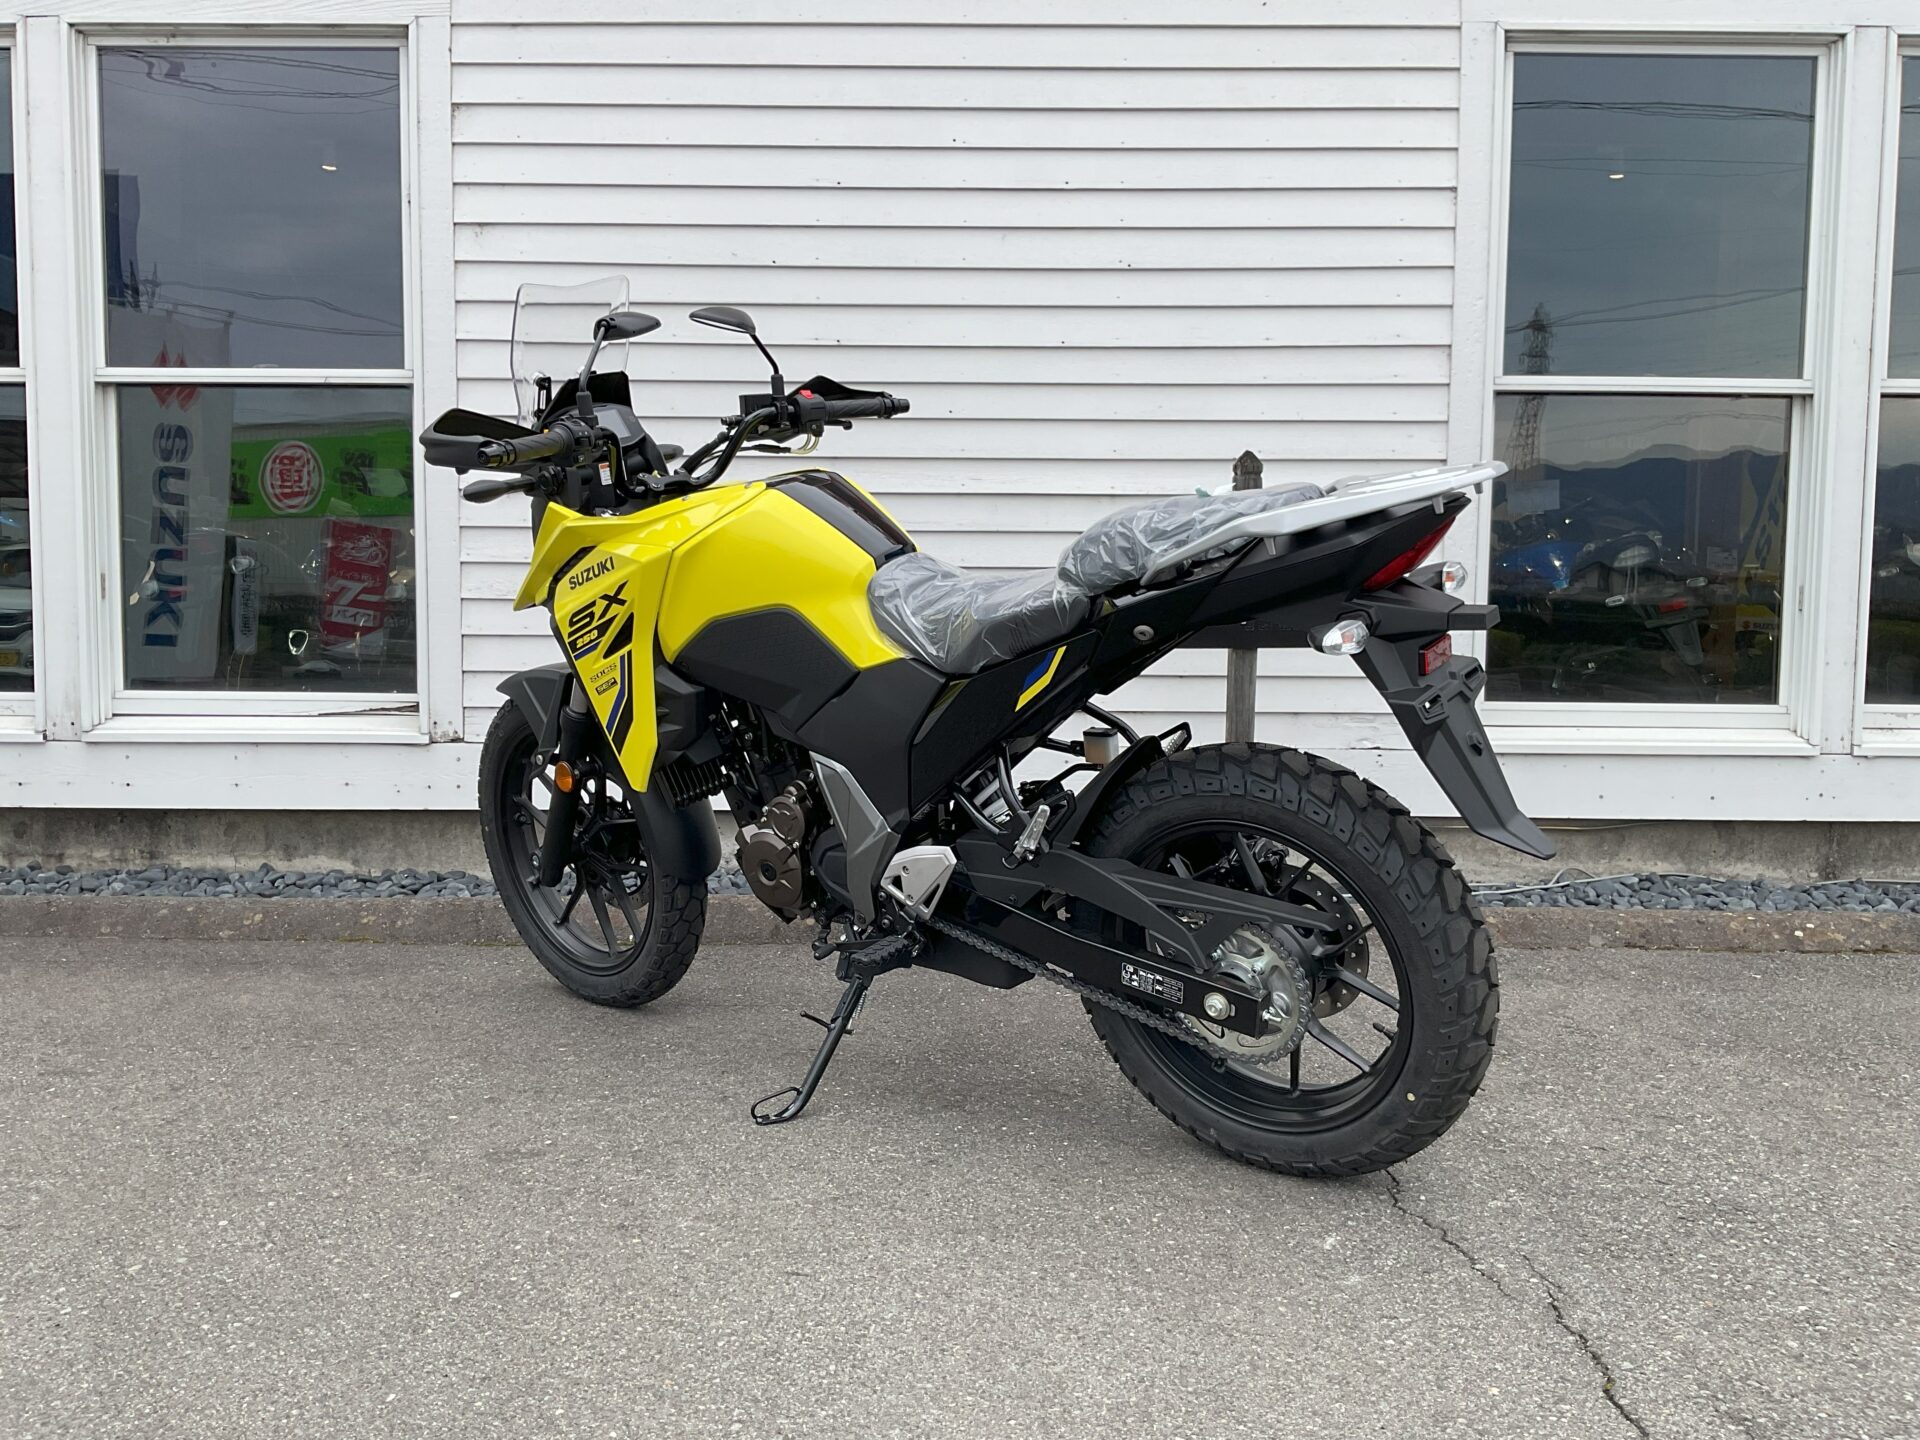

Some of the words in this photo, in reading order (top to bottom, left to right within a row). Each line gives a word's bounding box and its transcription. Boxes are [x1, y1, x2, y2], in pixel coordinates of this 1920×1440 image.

[143, 422, 194, 647] SUZUKI
[569, 556, 615, 589] SUZUKI
[569, 581, 628, 630] SX
[576, 630, 598, 648] 250
[597, 678, 616, 694] SEP
